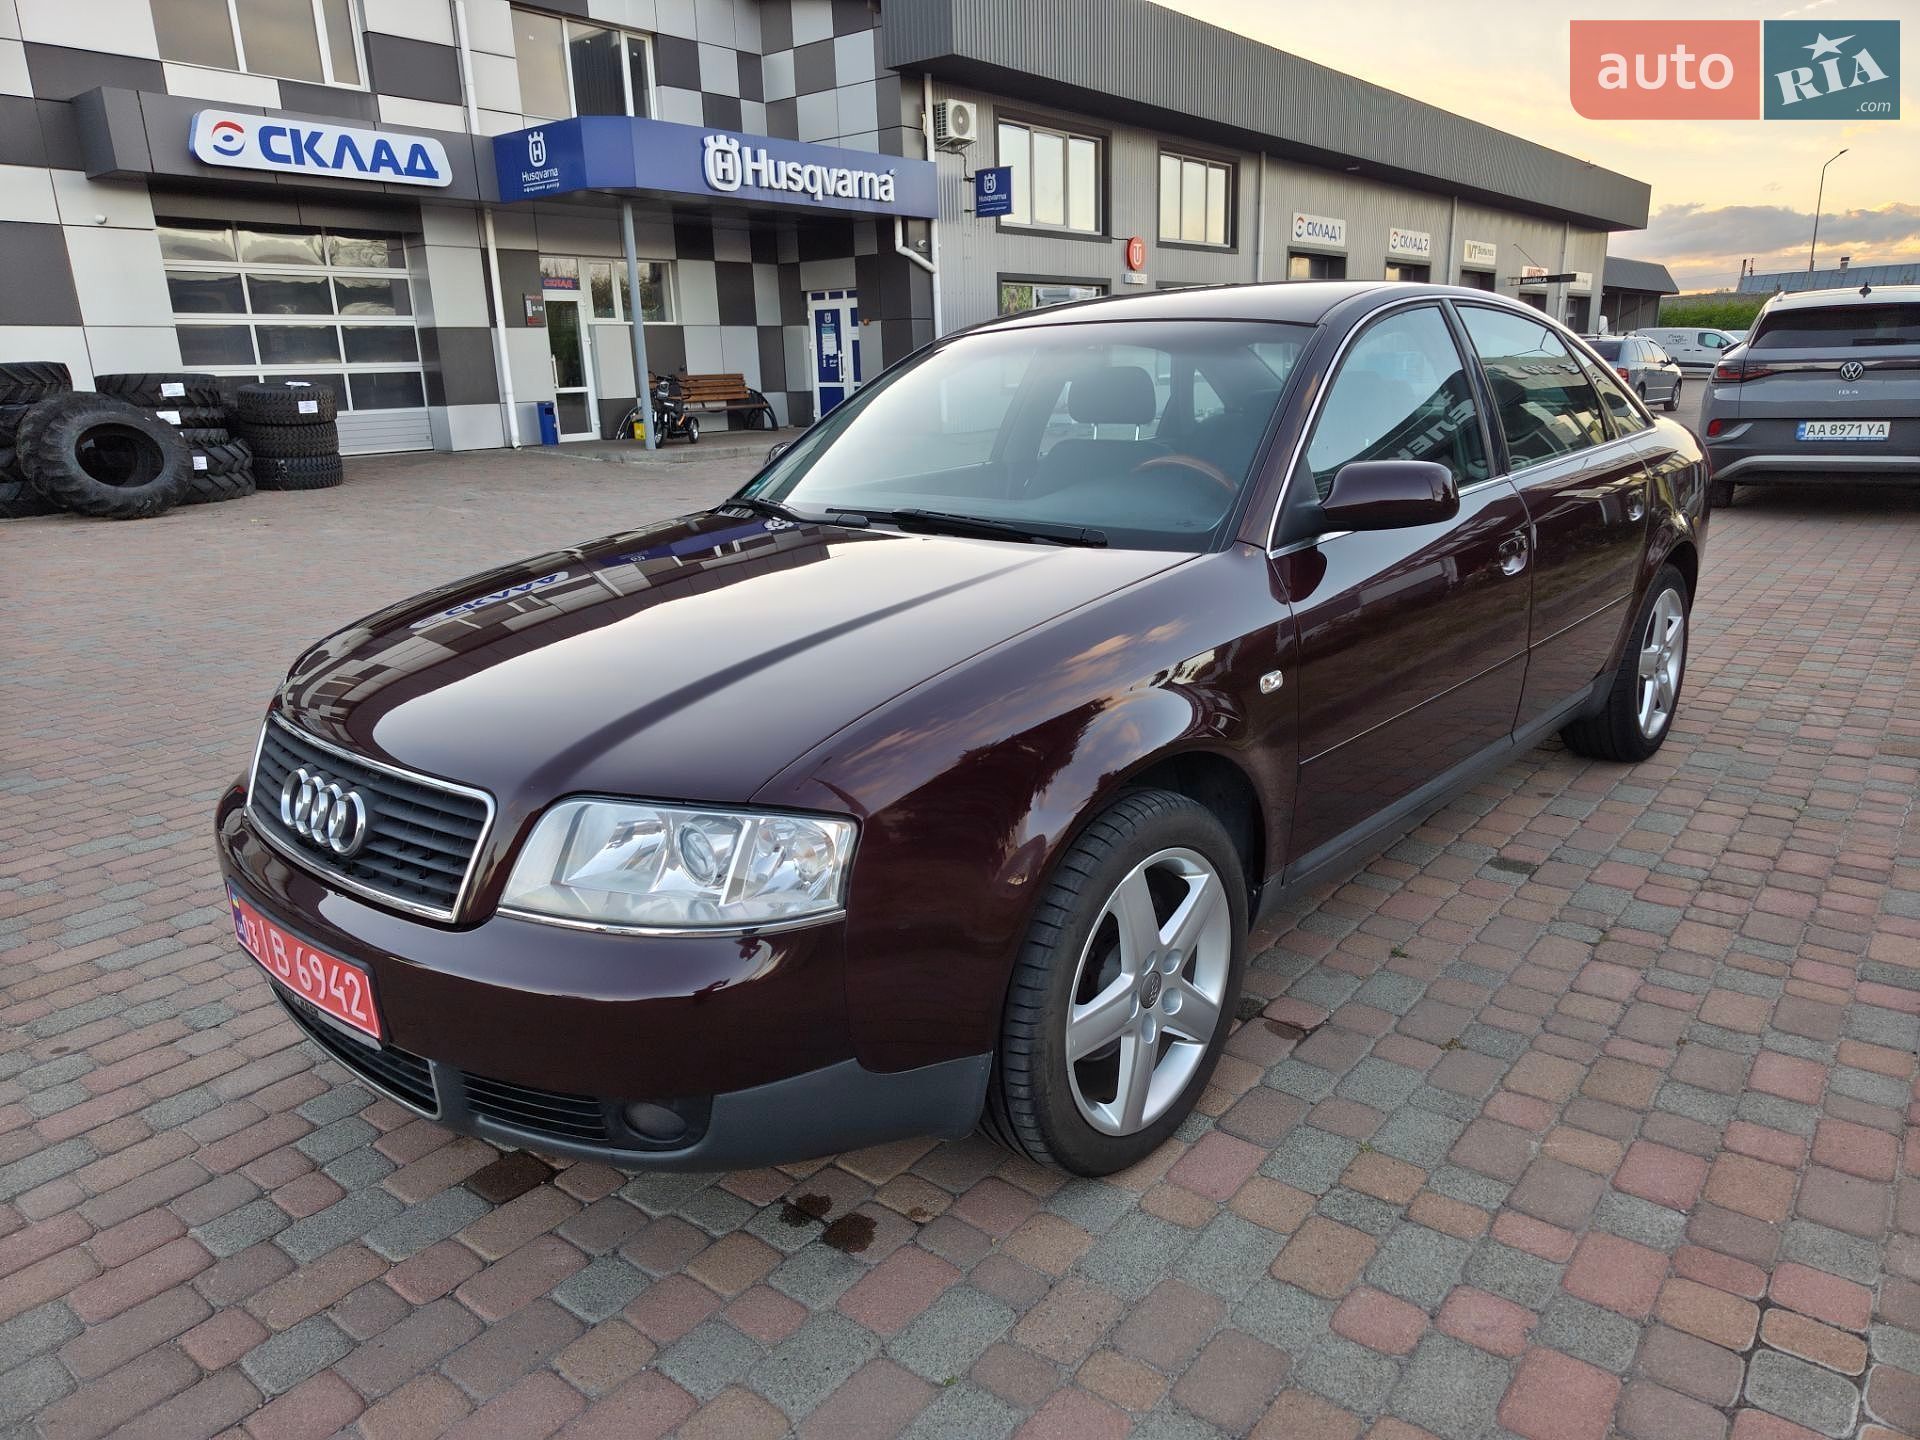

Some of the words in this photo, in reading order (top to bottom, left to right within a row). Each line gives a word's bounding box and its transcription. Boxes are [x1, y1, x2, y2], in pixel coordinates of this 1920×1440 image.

[258, 124, 440, 179] СКЛАД
[522, 167, 559, 183] Husqvarna
[741, 146, 896, 202] Husqvarna
[1306, 221, 1338, 242] СКЛАД
[1399, 235, 1423, 252] СКЛАД
[1424, 239, 1429, 251] 2
[1807, 424, 1826, 435] AA
[1829, 424, 1862, 435] 8971
[1866, 424, 1885, 435] YA
[295, 947, 368, 1022] 6942
